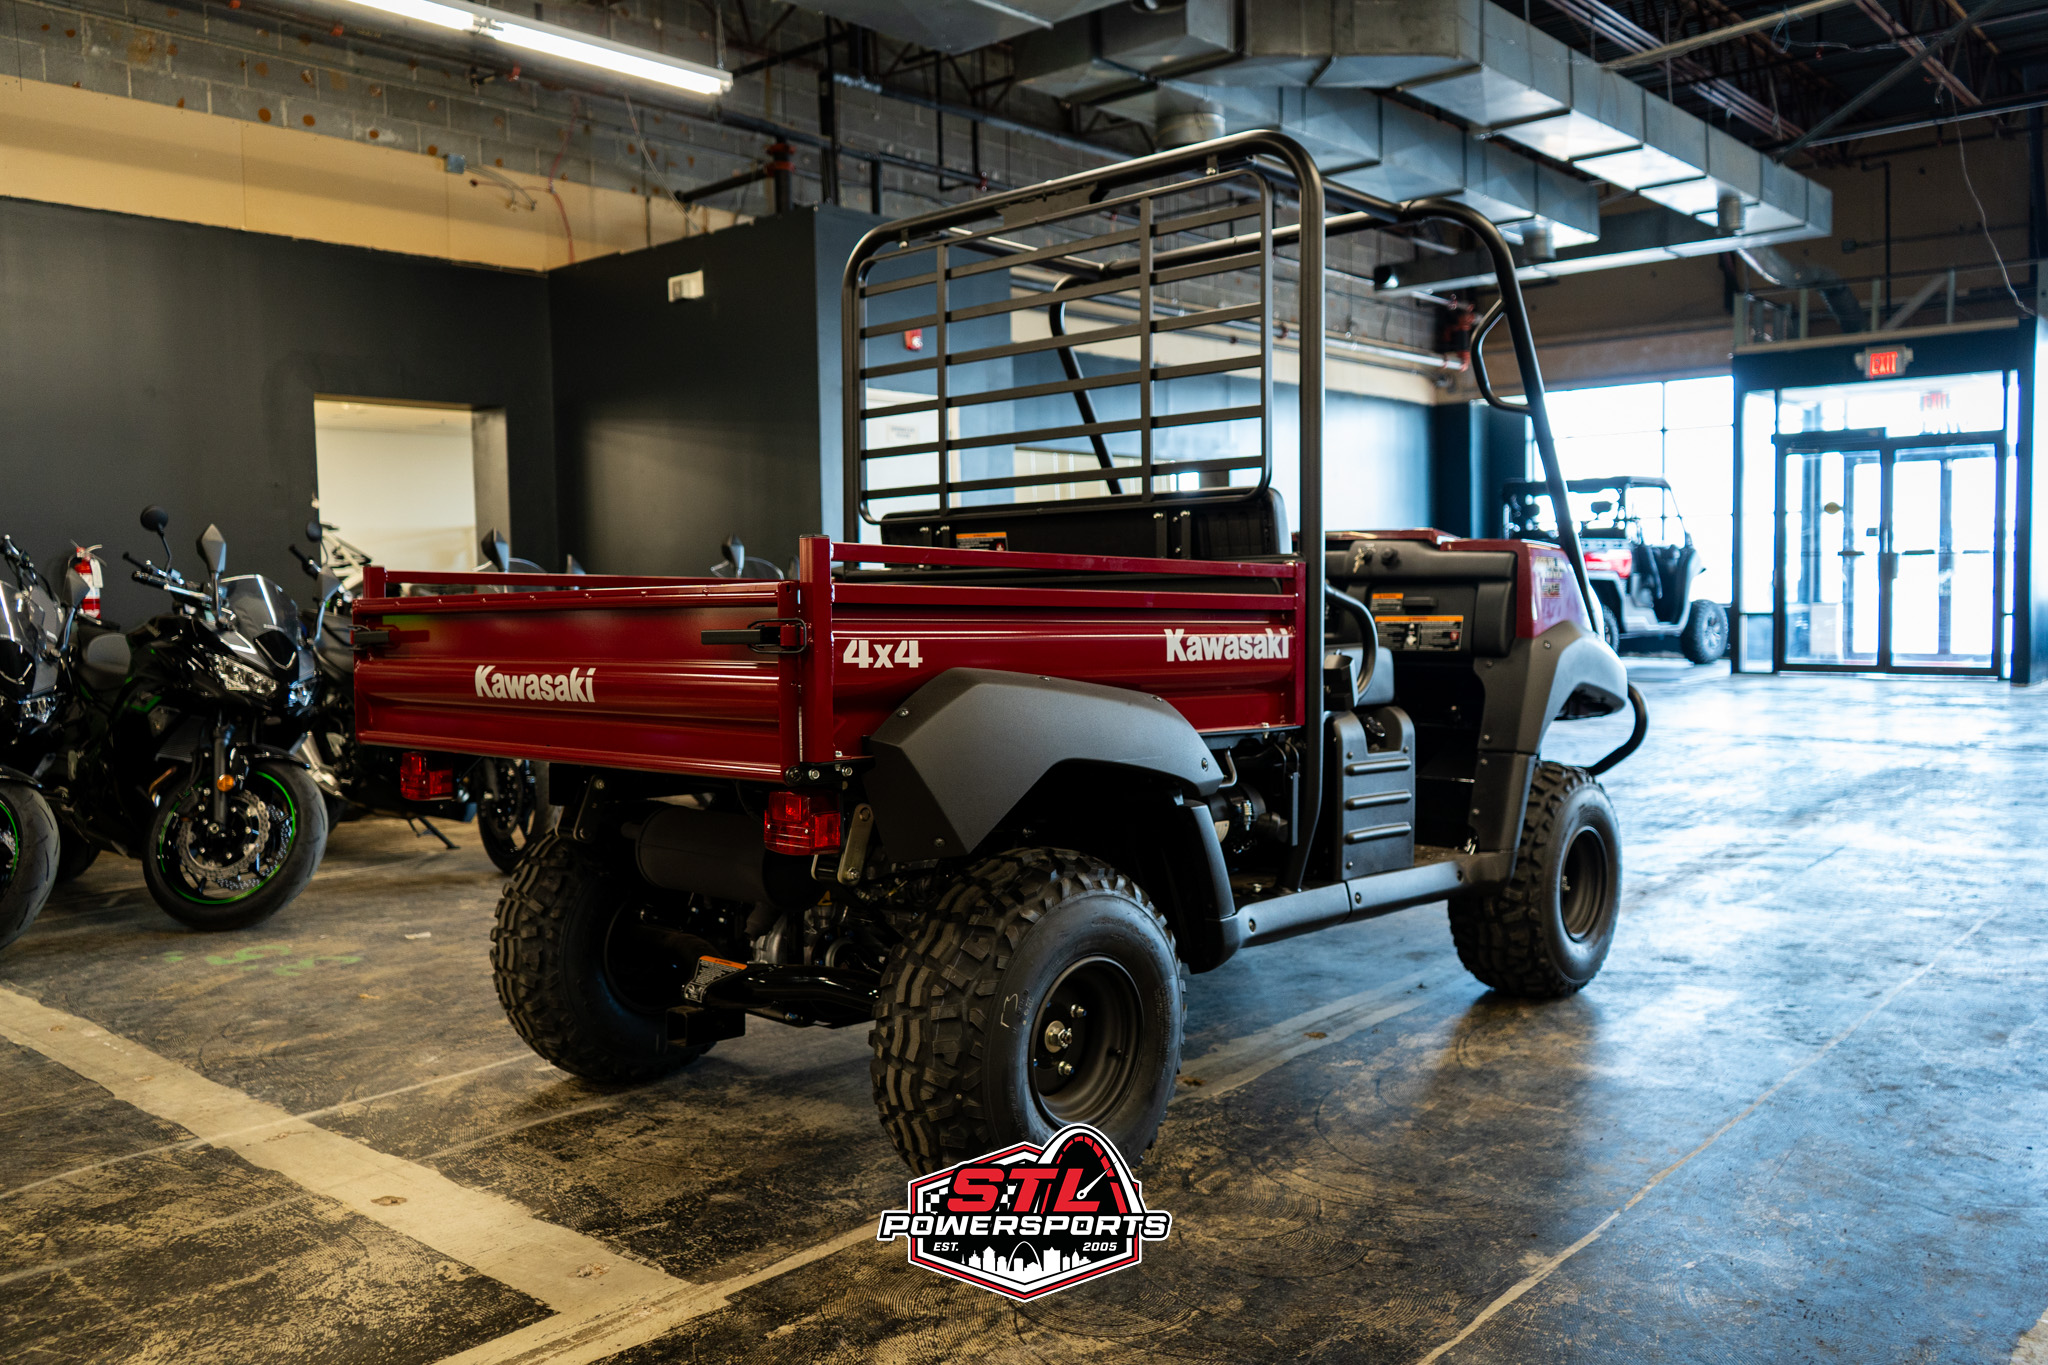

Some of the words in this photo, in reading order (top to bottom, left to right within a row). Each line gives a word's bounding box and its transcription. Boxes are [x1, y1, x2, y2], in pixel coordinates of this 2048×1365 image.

[1870, 352, 1898, 375] EXIT
[843, 640, 923, 669] 4x4
[1164, 628, 1290, 662] Kawasaki
[475, 665, 596, 703] Kawasaki
